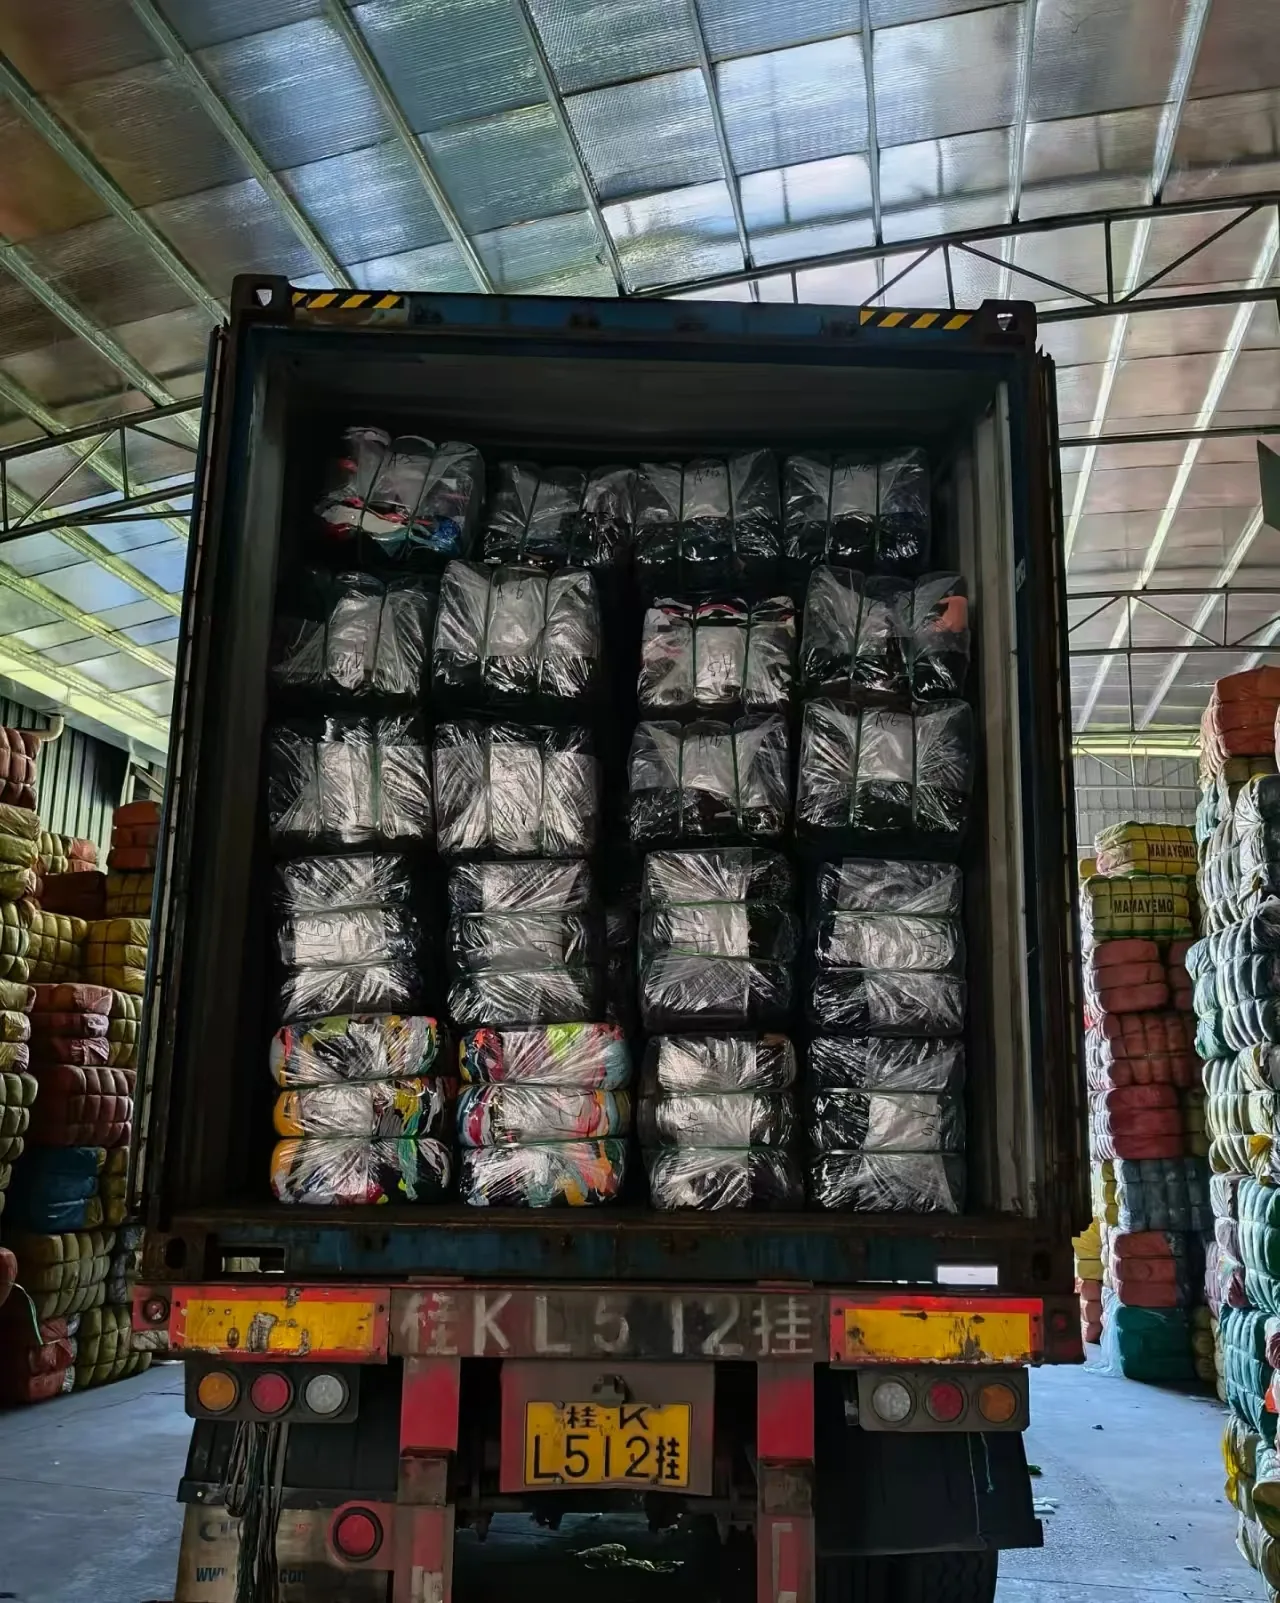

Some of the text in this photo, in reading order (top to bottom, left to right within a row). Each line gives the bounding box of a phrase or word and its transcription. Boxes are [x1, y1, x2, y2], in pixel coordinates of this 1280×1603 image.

[1148, 843, 1195, 858] MAMAYEMO
[1114, 899, 1174, 914] MAMAYEMO
[533, 1434, 680, 1480] L512挂
